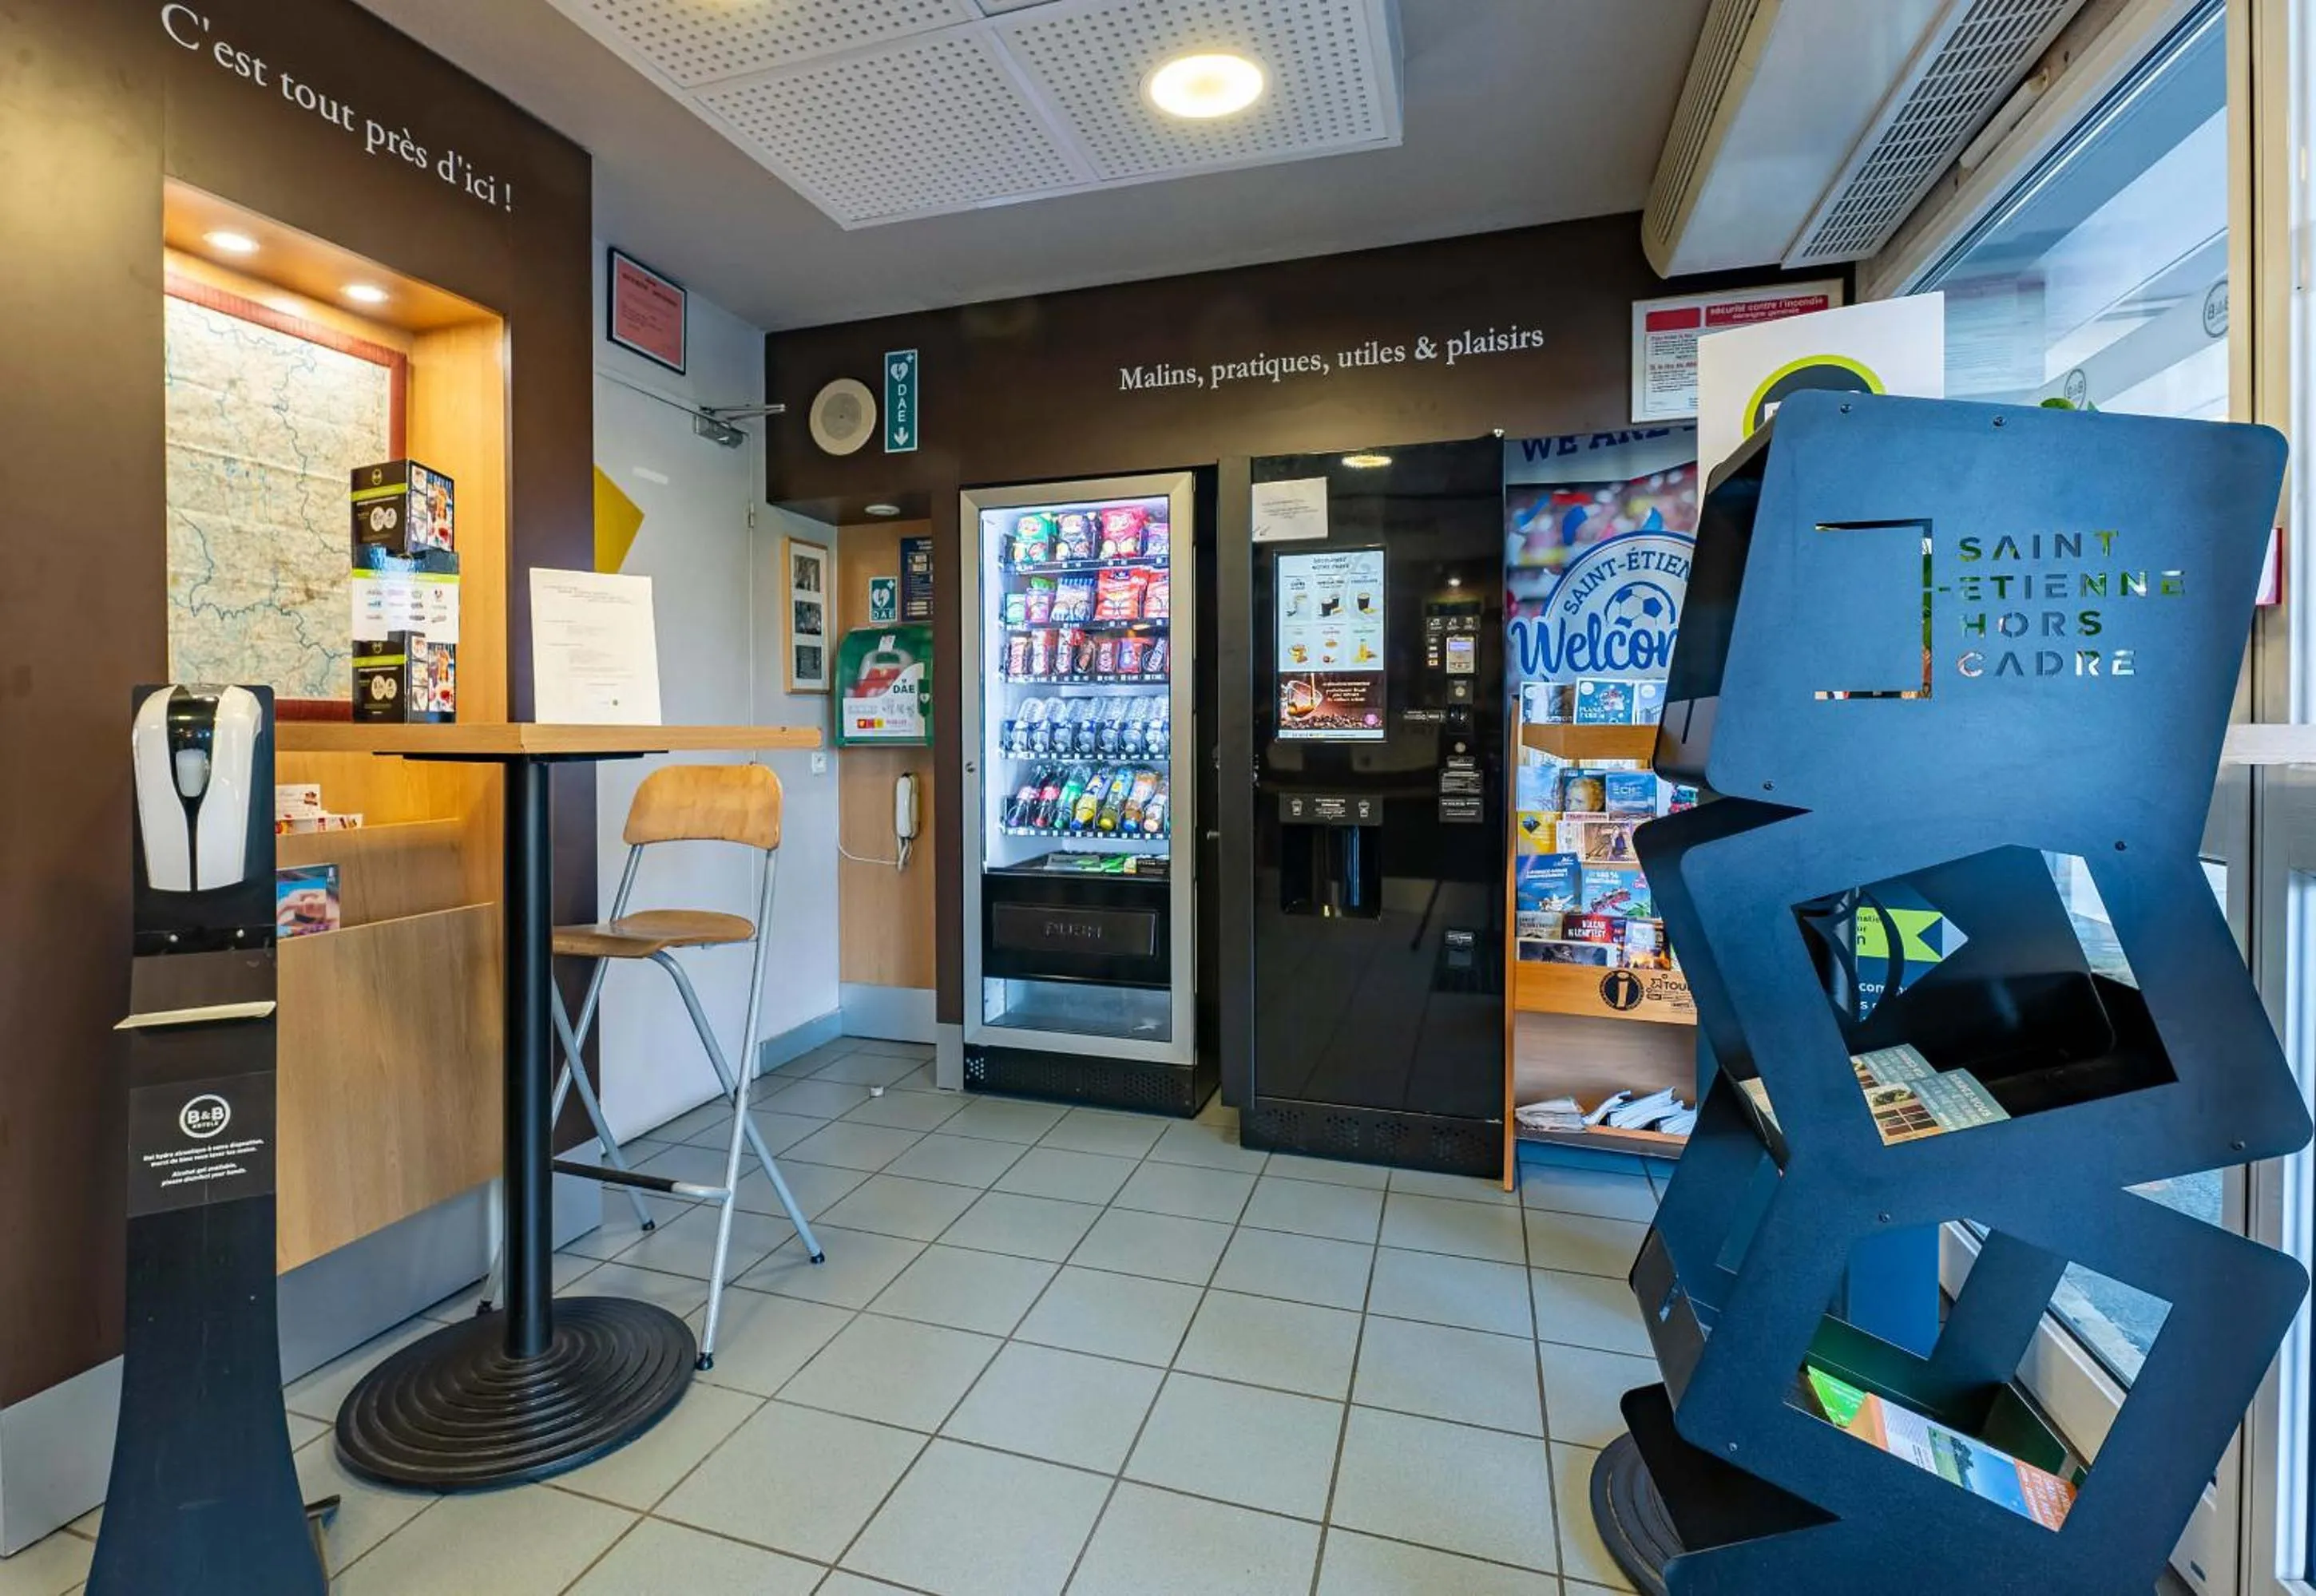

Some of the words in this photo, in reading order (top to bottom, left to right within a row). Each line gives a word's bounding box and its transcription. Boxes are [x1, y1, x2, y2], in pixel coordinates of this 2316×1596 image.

[161, 2, 268, 88] C'est
[280, 70, 354, 132] tout
[364, 118, 428, 170] près
[437, 149, 497, 207] d'ici
[1119, 364, 1204, 390] Malins,
[1210, 352, 1330, 390] pratiques,
[1338, 341, 1406, 370] utiles
[1414, 335, 1438, 361] &
[1446, 325, 1545, 365] plaisirs
[1958, 529, 2119, 561] SAINT
[872, 610, 895, 620] DAE
[1960, 610, 2103, 639] HORS
[1957, 649, 2136, 679] CADRE
[893, 683, 915, 694] DAE
[187, 1106, 224, 1125] B&B
